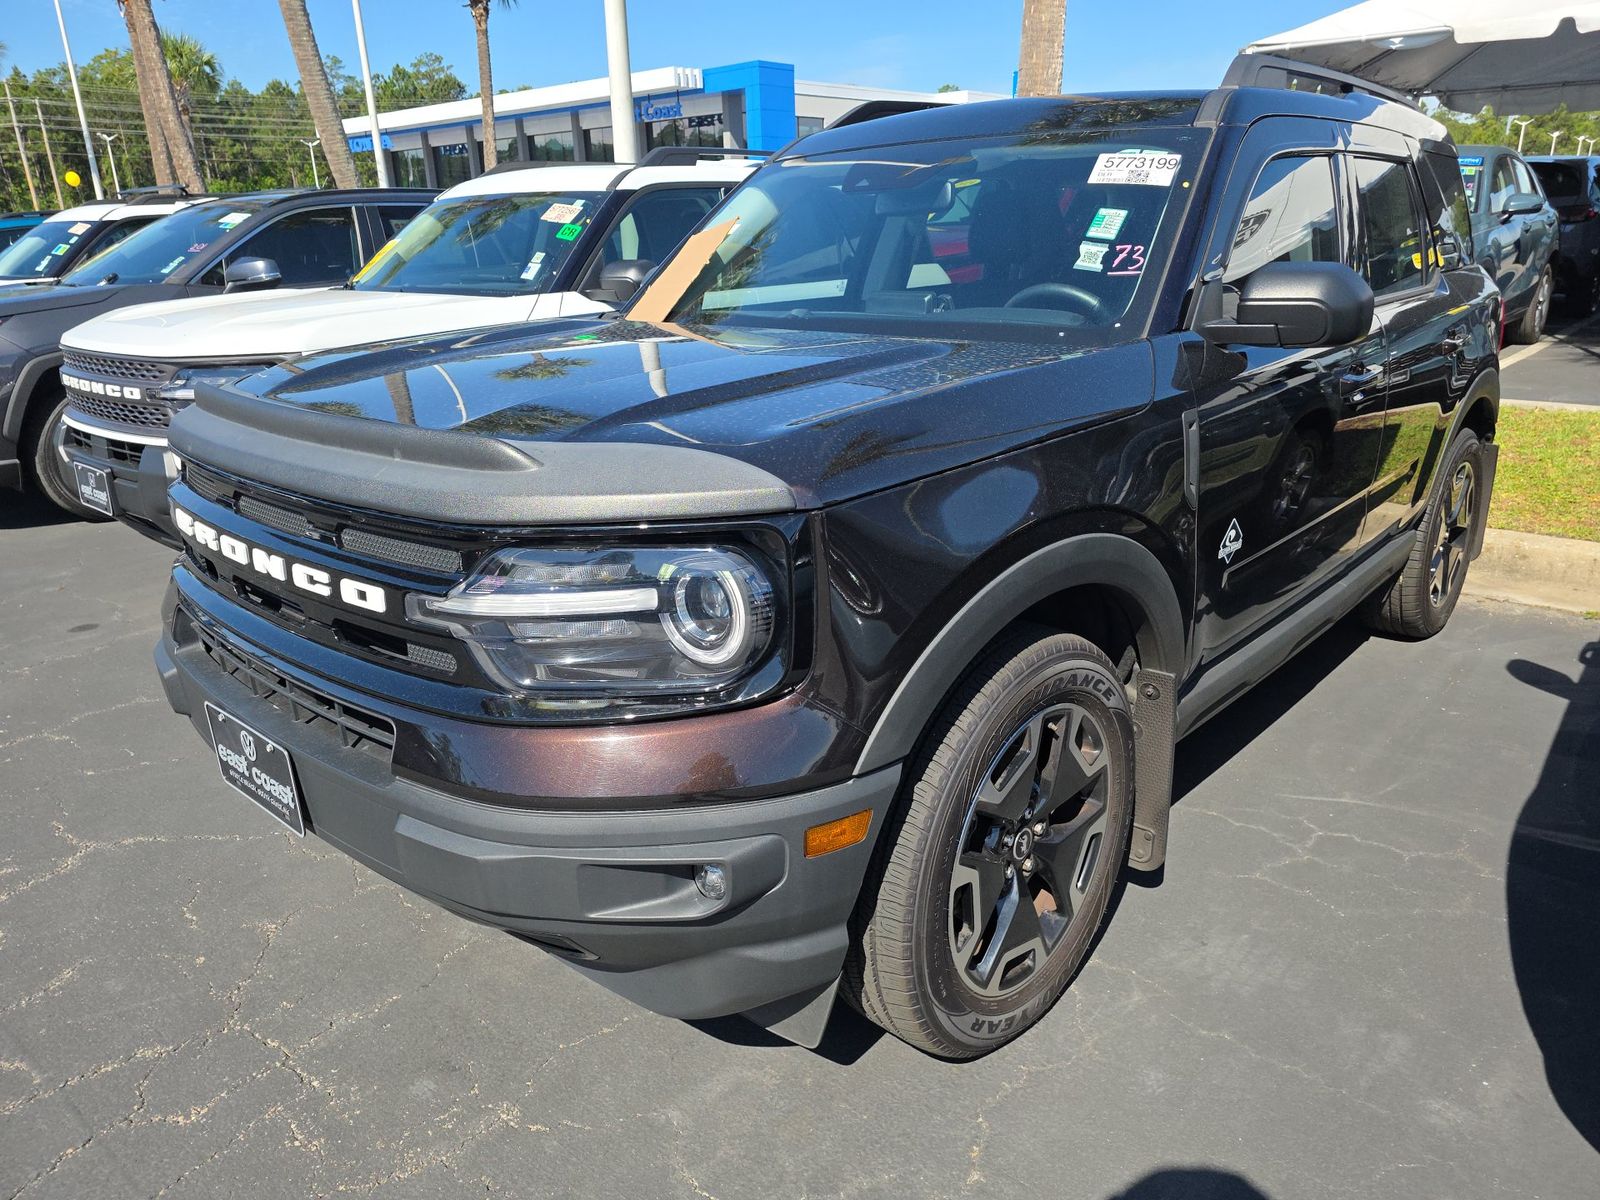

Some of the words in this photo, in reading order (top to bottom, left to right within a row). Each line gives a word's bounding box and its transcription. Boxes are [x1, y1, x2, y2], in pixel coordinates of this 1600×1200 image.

[1104, 156, 1178, 170] 5773199
[1112, 245, 1145, 270] 73
[62, 373, 141, 400] BRONCO
[175, 508, 386, 613] BRONCO
[218, 743, 249, 777] east
[252, 766, 295, 809] coast
